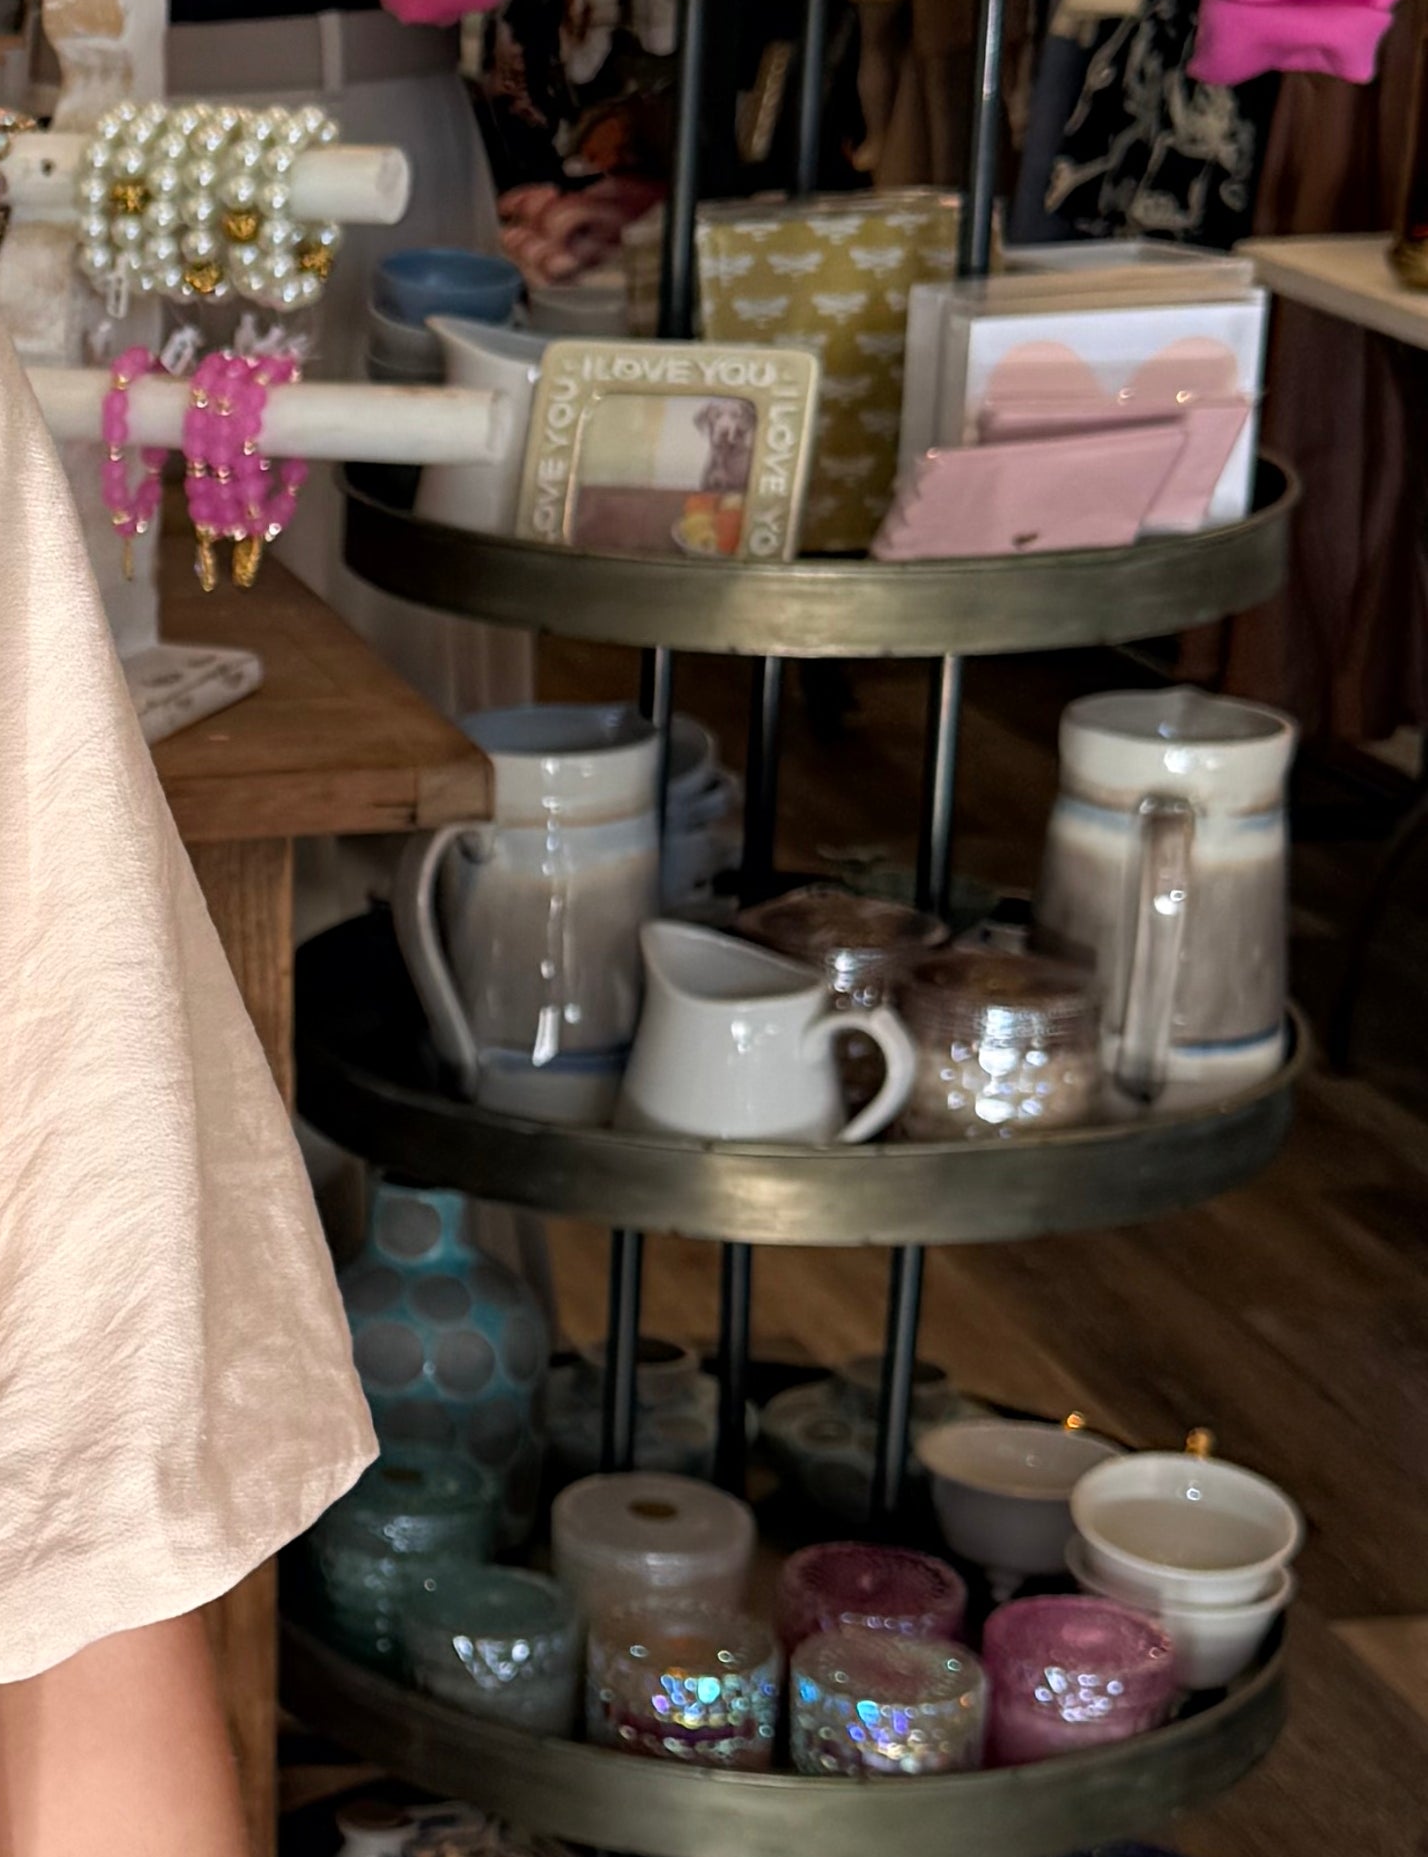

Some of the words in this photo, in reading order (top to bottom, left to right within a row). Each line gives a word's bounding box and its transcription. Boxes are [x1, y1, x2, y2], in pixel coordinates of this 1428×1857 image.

[596, 356, 691, 385] LOVE
[695, 361, 778, 387] YOU
[546, 374, 579, 448] YOU
[758, 401, 798, 496] LOVE
[749, 507, 784, 557] YO
